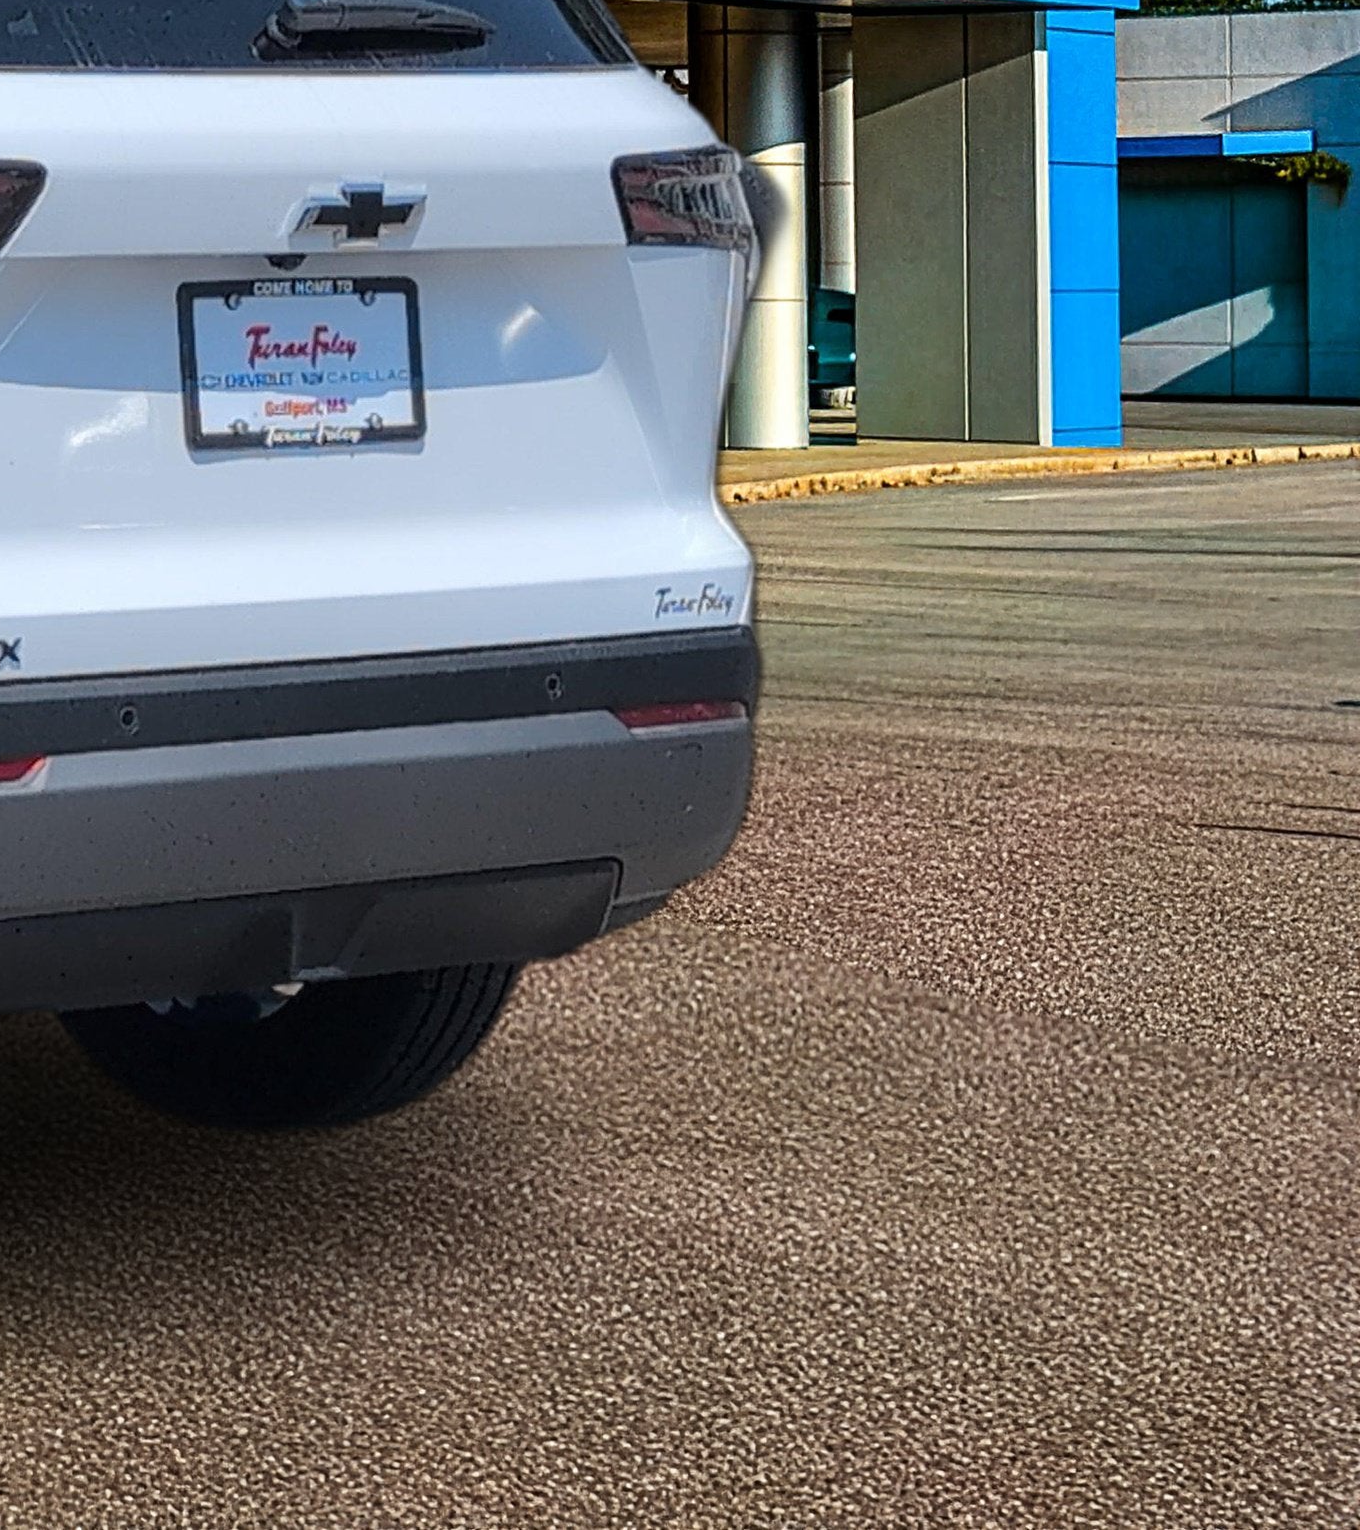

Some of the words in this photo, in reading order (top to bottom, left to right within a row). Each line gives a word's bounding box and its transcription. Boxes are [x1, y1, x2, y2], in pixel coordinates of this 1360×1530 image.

[335, 280, 354, 294] TO
[225, 372, 293, 389] CHEVROLET
[327, 369, 409, 385] CADILLAC
